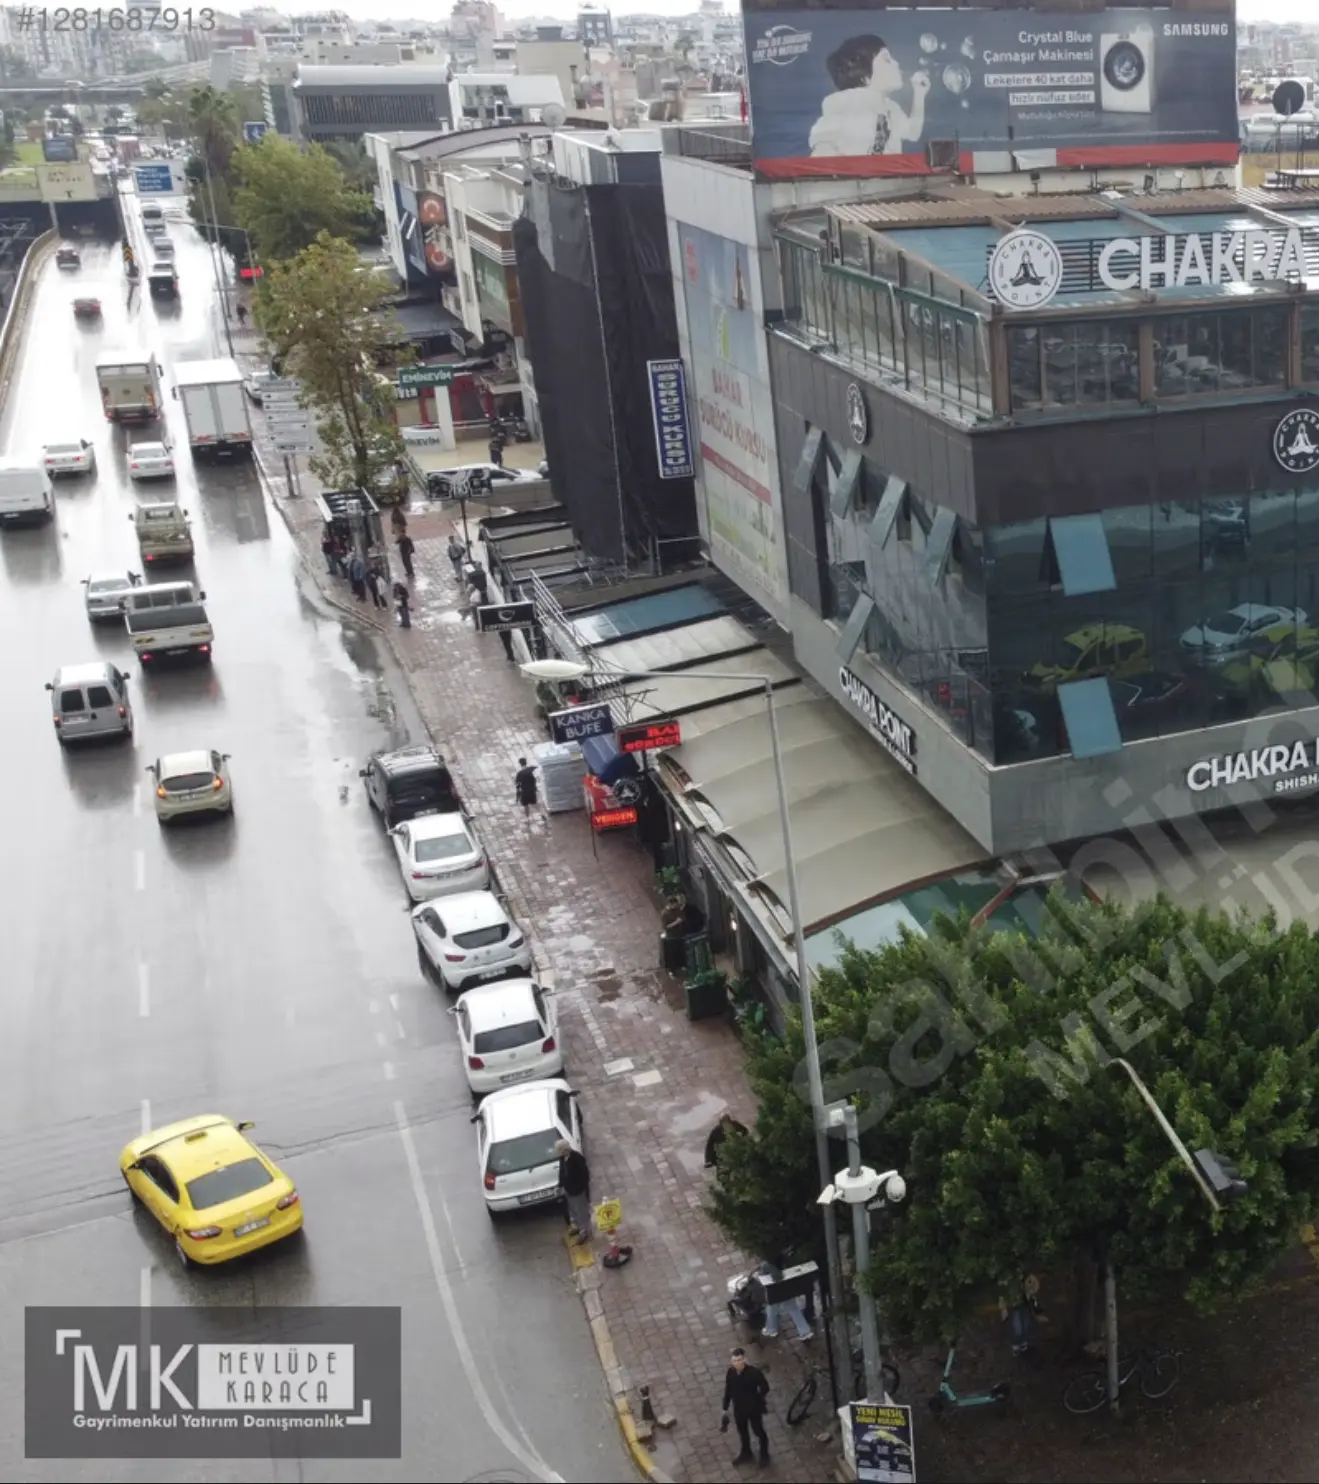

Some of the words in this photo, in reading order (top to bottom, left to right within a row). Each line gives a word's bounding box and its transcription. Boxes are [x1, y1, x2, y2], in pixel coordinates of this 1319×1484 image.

[1018, 31, 1063, 46] Crystal
[1065, 31, 1093, 43] Blue
[1163, 23, 1228, 36] SAMSUNG
[983, 51, 1035, 65] Çamaşır
[1038, 50, 1093, 61] Makinesi
[1002, 240, 1050, 259] CHAKRA
[1099, 229, 1307, 291] CHAKRA
[556, 708, 606, 728] KANKA
[879, 703, 911, 756] POINT
[1187, 741, 1308, 791] CHAKRA
